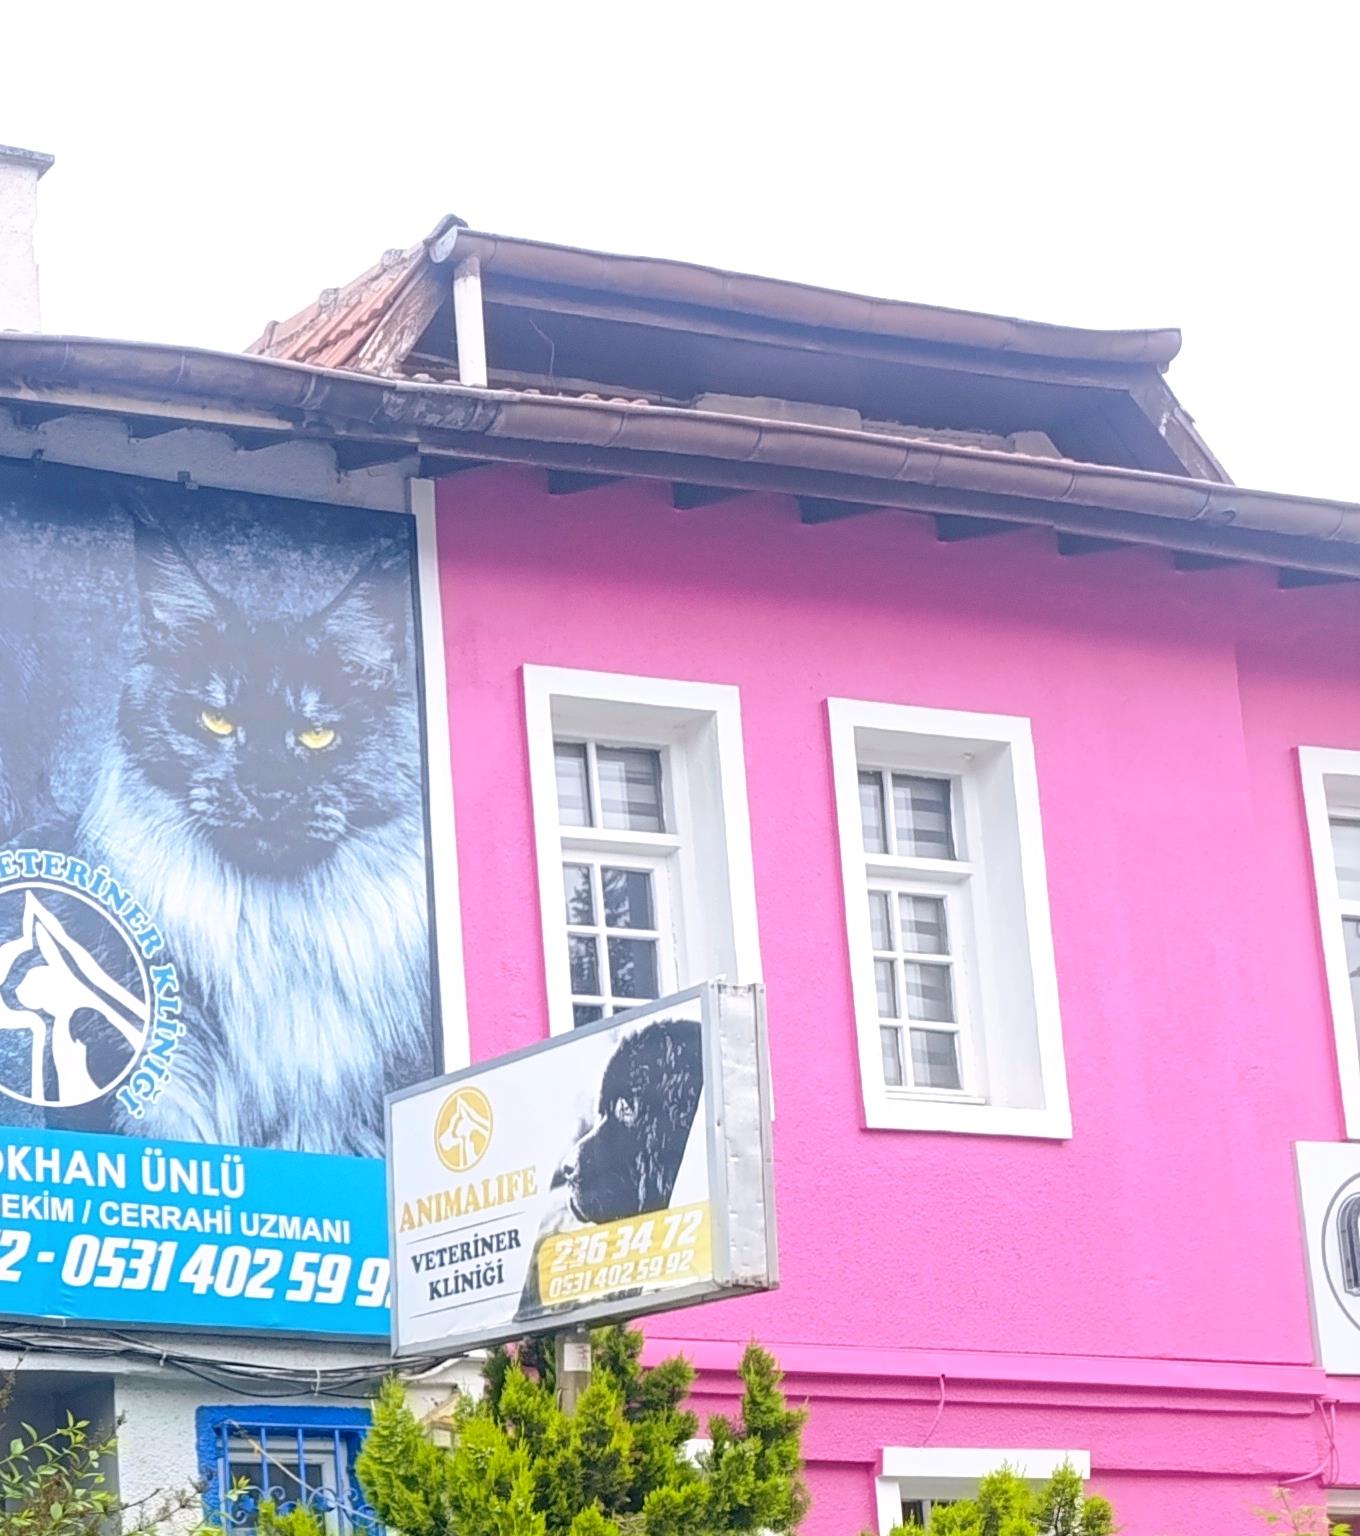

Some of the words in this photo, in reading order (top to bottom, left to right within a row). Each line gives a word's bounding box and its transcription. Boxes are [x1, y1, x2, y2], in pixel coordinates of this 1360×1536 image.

[117, 963, 186, 1119] KLİNİĞİ
[141, 1147, 245, 1199] ÜNLÜ
[399, 1166, 537, 1232] ANIMALIFE
[99, 1200, 232, 1235] CERRAHİ
[240, 1211, 351, 1245] UZMANI
[551, 1230, 609, 1273] 236
[611, 1220, 655, 1260] 34
[662, 1209, 704, 1249] 72
[61, 1233, 178, 1292] 0531
[179, 1243, 284, 1299] 402
[285, 1251, 352, 1304] 59
[355, 1256, 391, 1309] 9
[411, 1228, 521, 1274] VETERİNER
[549, 1270, 593, 1298] 0531
[594, 1261, 635, 1289] 402
[636, 1255, 664, 1281] 59
[665, 1249, 694, 1275] 92
[429, 1258, 505, 1301] KLİNİĞİ
